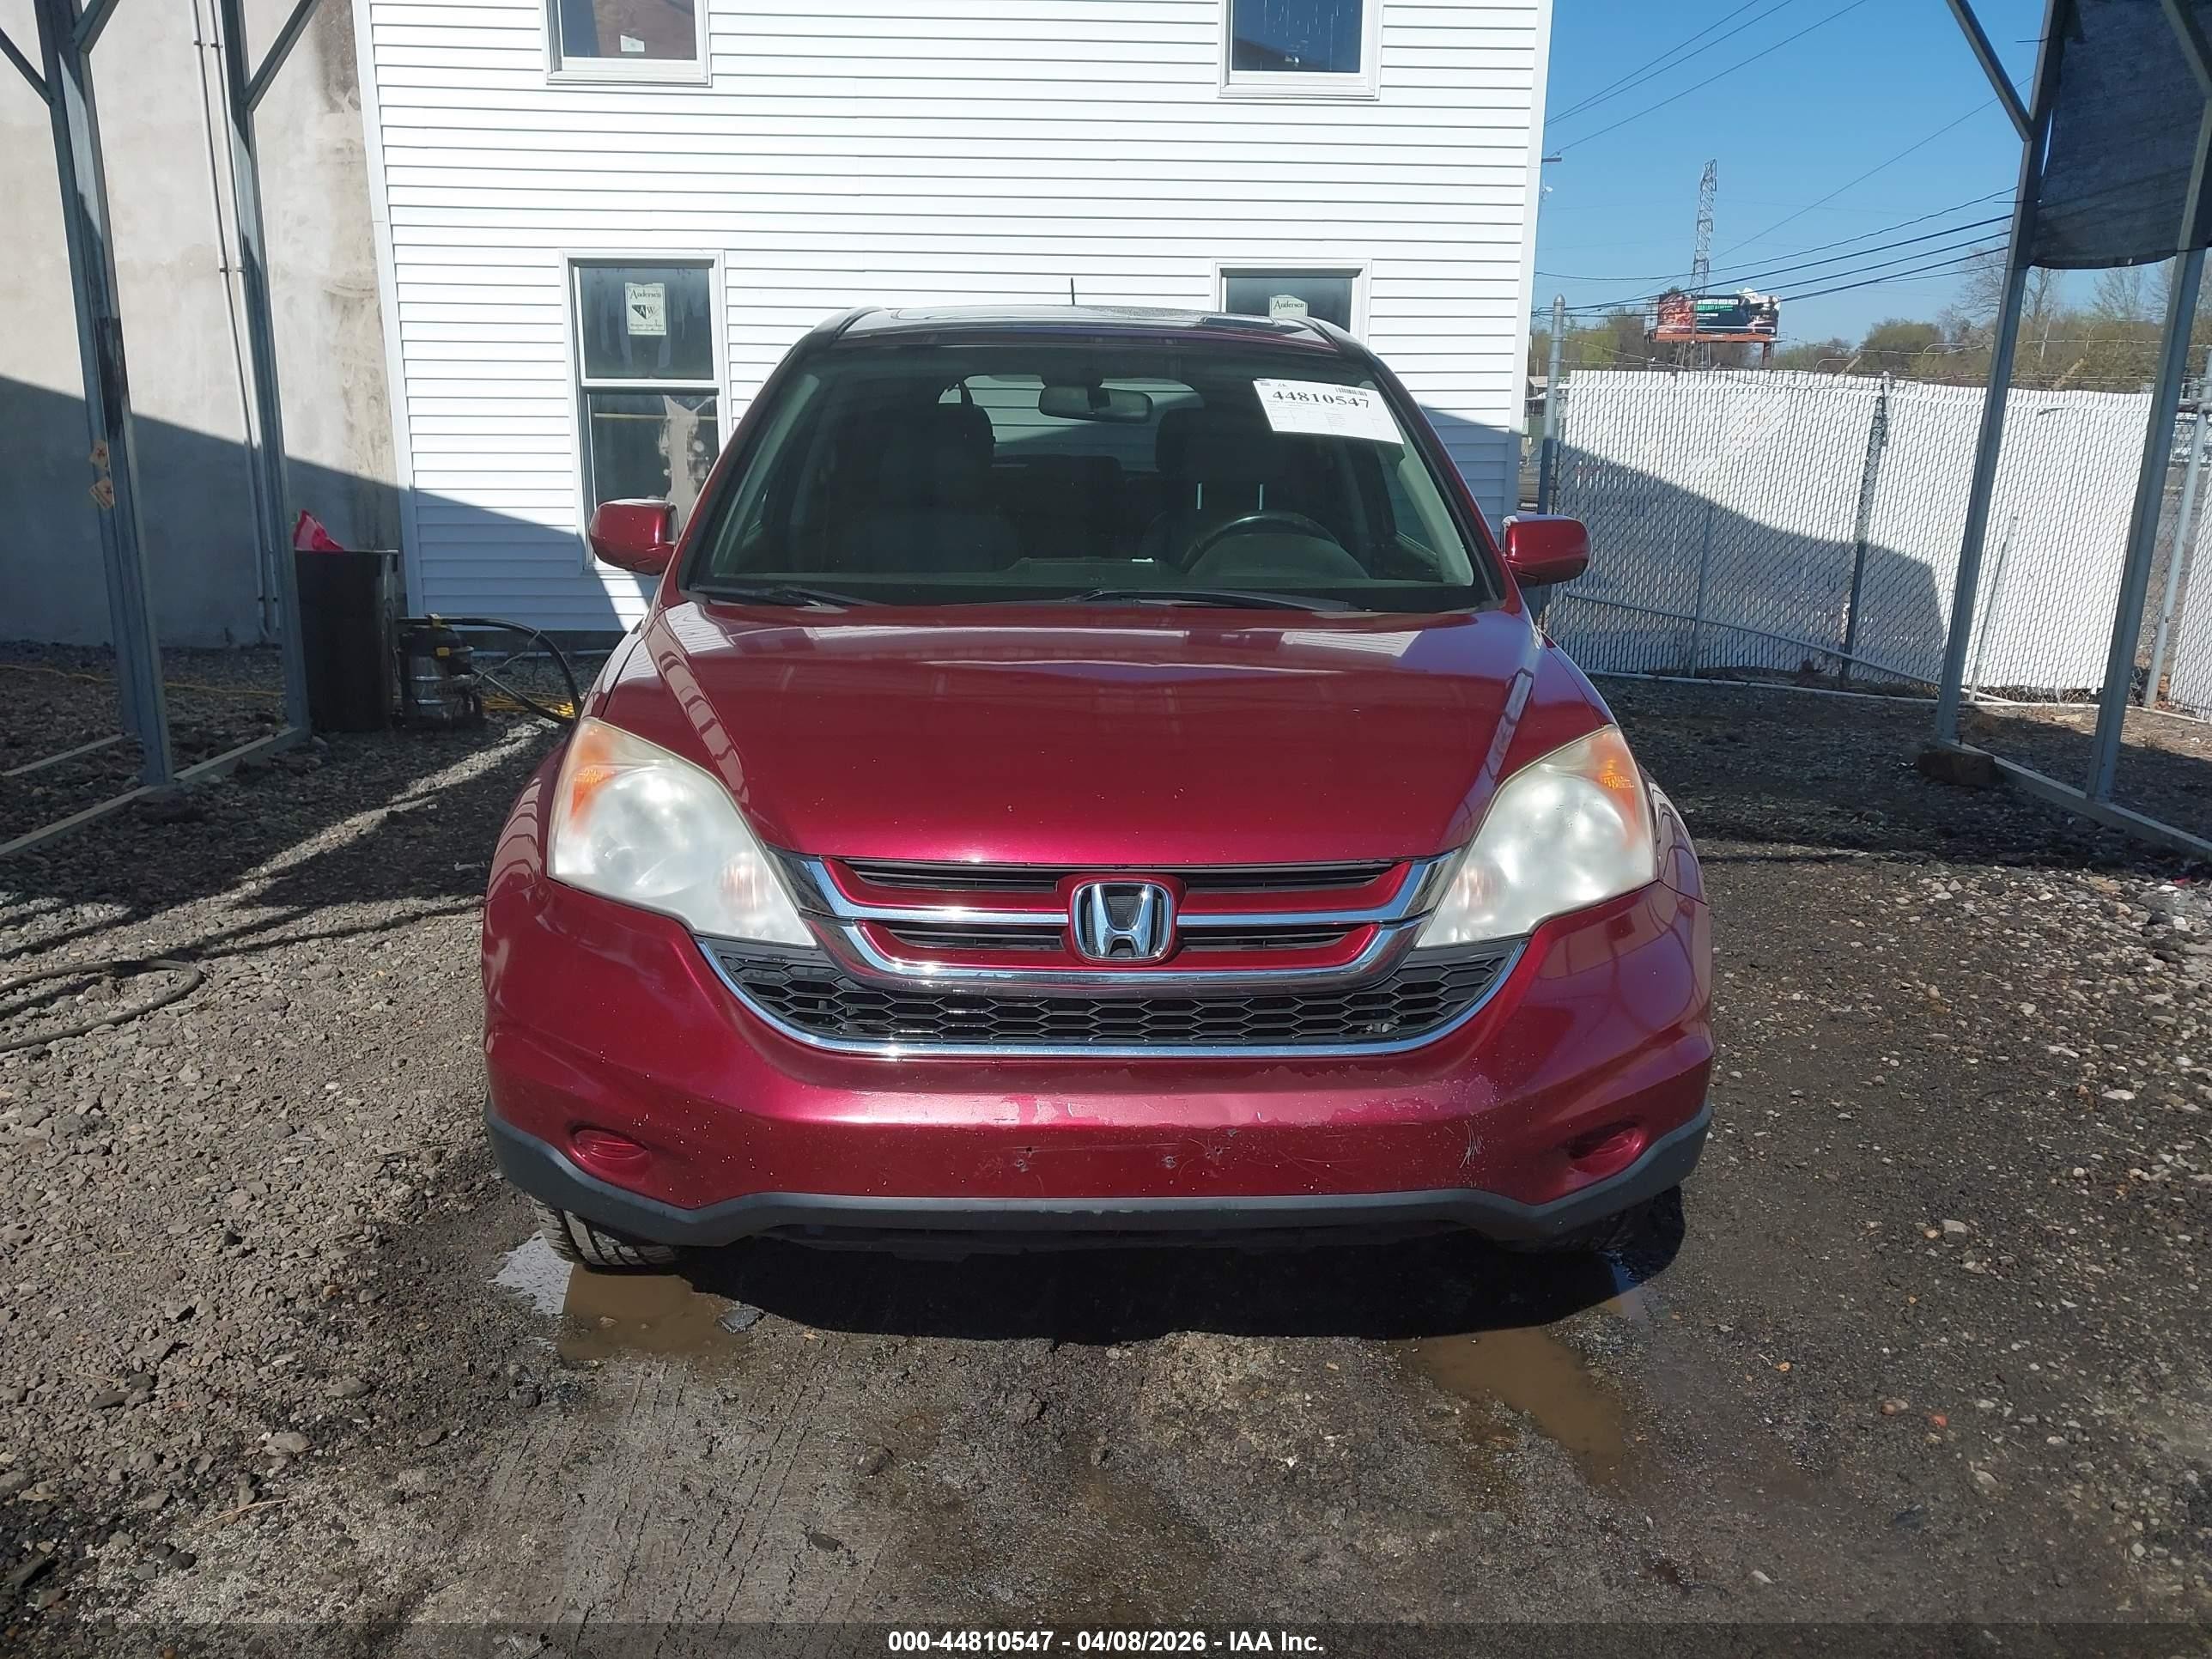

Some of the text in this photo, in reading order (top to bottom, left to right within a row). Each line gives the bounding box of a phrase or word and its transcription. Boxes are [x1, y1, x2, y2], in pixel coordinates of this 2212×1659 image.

[629, 289, 661, 300] Andersen
[1273, 300, 1304, 310] Andersen
[1273, 391, 1370, 409] 44810547
